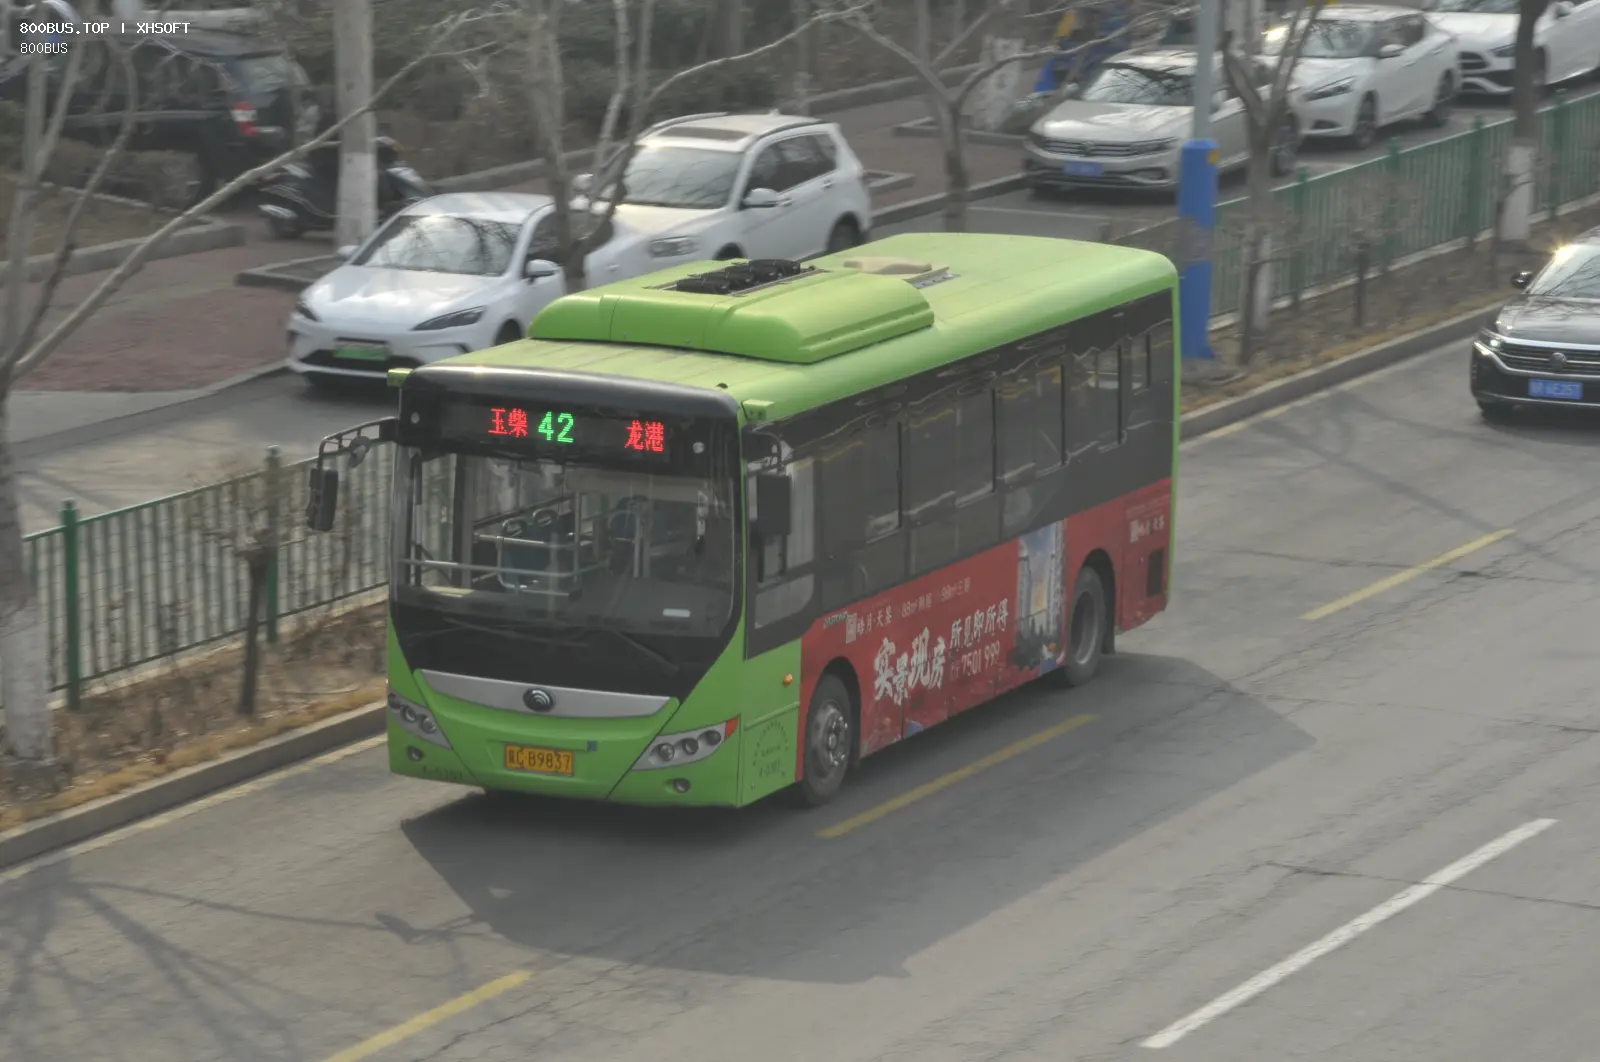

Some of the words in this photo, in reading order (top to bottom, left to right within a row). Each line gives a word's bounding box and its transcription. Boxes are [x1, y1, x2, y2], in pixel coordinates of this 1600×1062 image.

[488, 407, 528, 438] 玉柴
[538, 411, 574, 443] 42
[624, 420, 665, 452] 龙港
[950, 598, 1008, 649] 所见即所得
[875, 627, 946, 705] 实景现房
